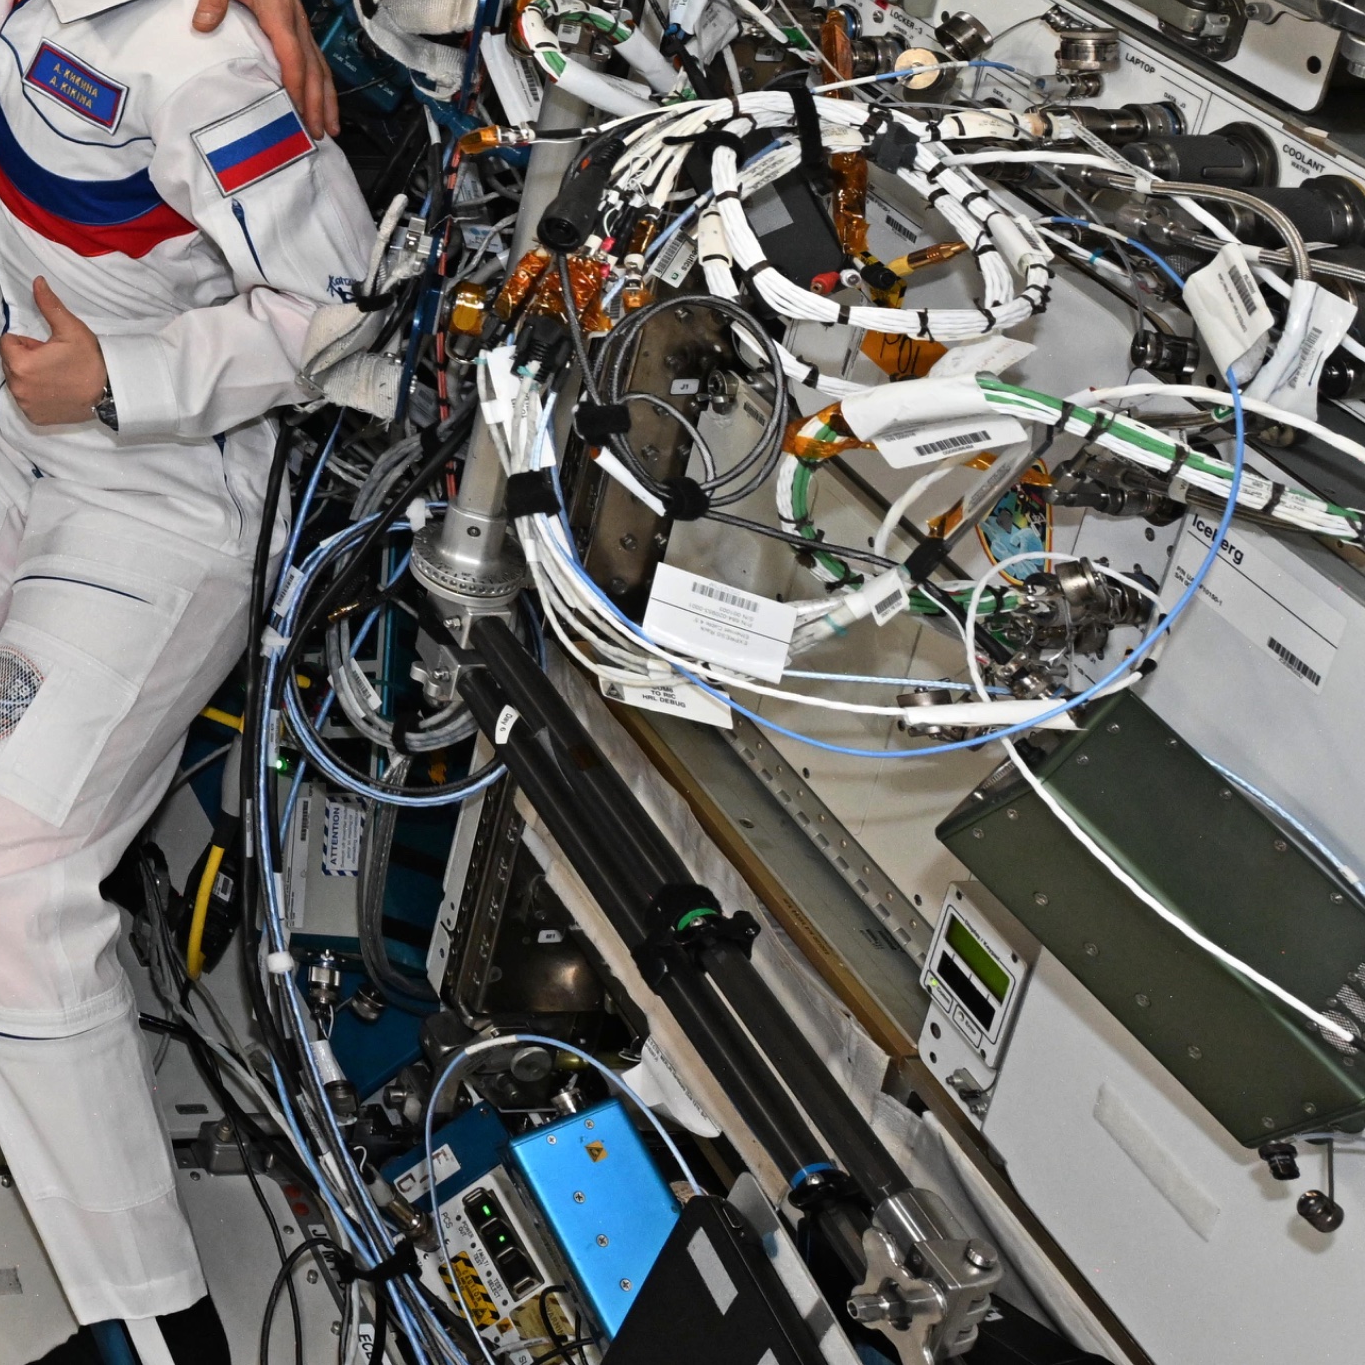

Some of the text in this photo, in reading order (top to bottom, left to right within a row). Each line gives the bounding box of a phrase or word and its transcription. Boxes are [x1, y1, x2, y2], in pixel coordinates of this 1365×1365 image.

[889, 8, 924, 35] LOCKER-3
[1124, 52, 1157, 75] LAPTOP
[63, 67, 100, 98] КИКИНА
[59, 81, 94, 110] KIKINA
[1281, 142, 1327, 174] COOLANT
[1290, 160, 1311, 176] WATER
[650, 690, 662, 698] TO
[659, 696, 687, 708] DEBUG
[501, 711, 513, 727] Day
[330, 806, 341, 866] ATTENTION
